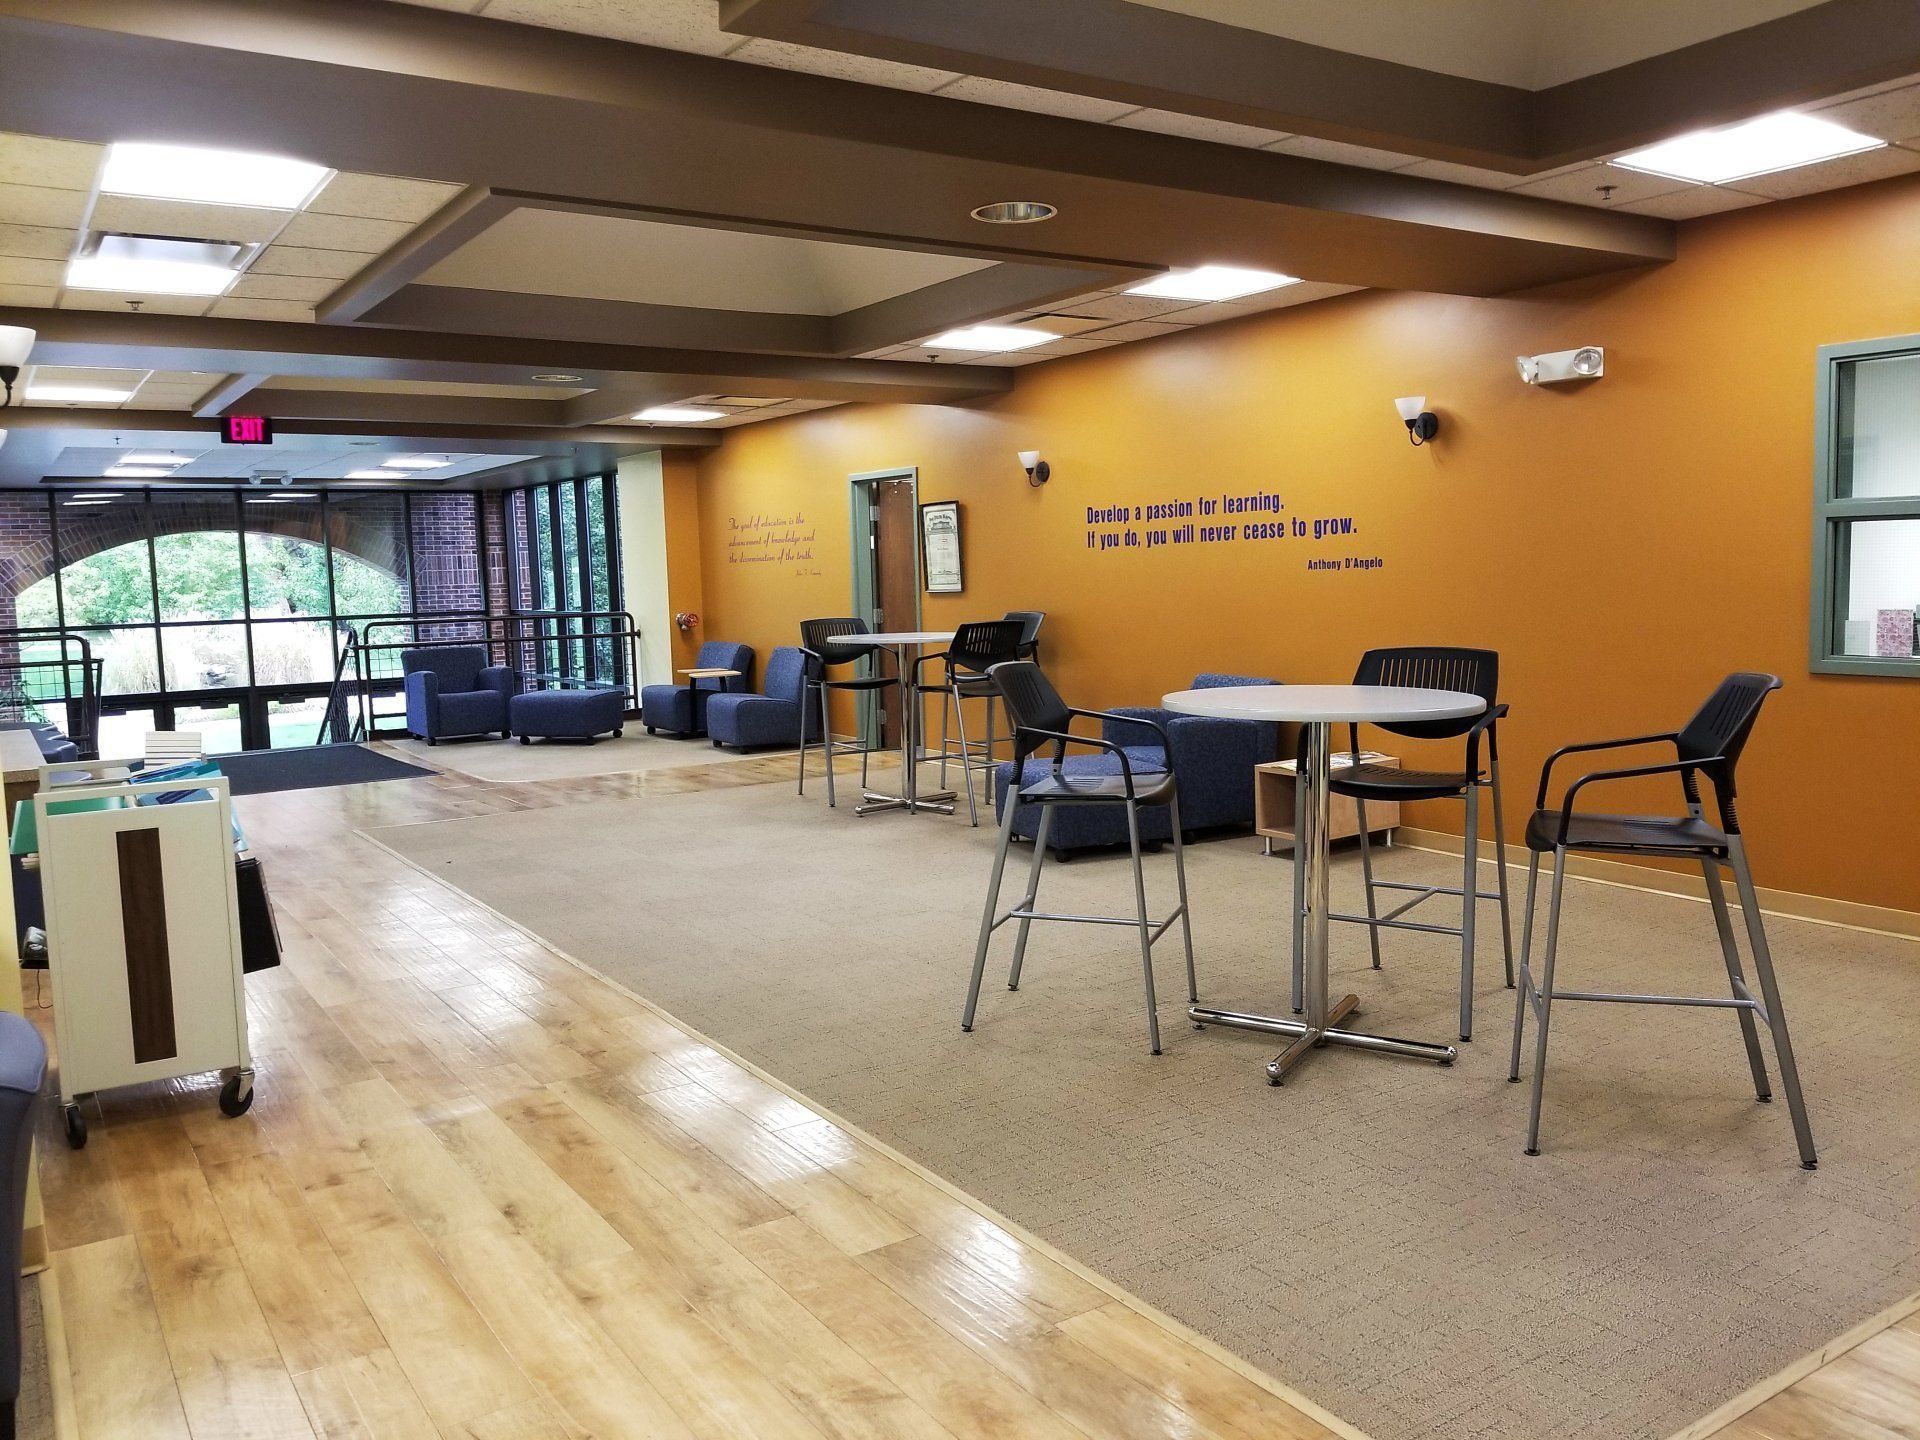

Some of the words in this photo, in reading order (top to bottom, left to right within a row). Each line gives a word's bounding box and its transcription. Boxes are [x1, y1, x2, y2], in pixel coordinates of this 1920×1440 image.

[231, 418, 264, 441] EXIT
[1087, 505, 1130, 525] Develop
[1134, 506, 1141, 521] a
[1146, 499, 1192, 522] passion
[1198, 496, 1217, 516] for
[1223, 491, 1285, 514] learning.
[728, 517, 739, 530] The
[796, 512, 804, 525] the
[763, 531, 771, 549] of
[802, 529, 816, 542] and
[1087, 530, 1095, 549] If
[1100, 532, 1119, 551] you
[1124, 528, 1141, 548] do,
[1146, 529, 1167, 549] you
[1172, 523, 1194, 544] will
[1200, 524, 1237, 543] never
[1243, 521, 1285, 541] cease
[1292, 516, 1307, 538] to
[1313, 517, 1358, 540] grow.
[729, 552, 738, 564] the
[777, 547, 785, 565] of
[785, 548, 795, 561] the
[1307, 558, 1342, 571] Anthony
[1345, 556, 1383, 570] D'Angelo
